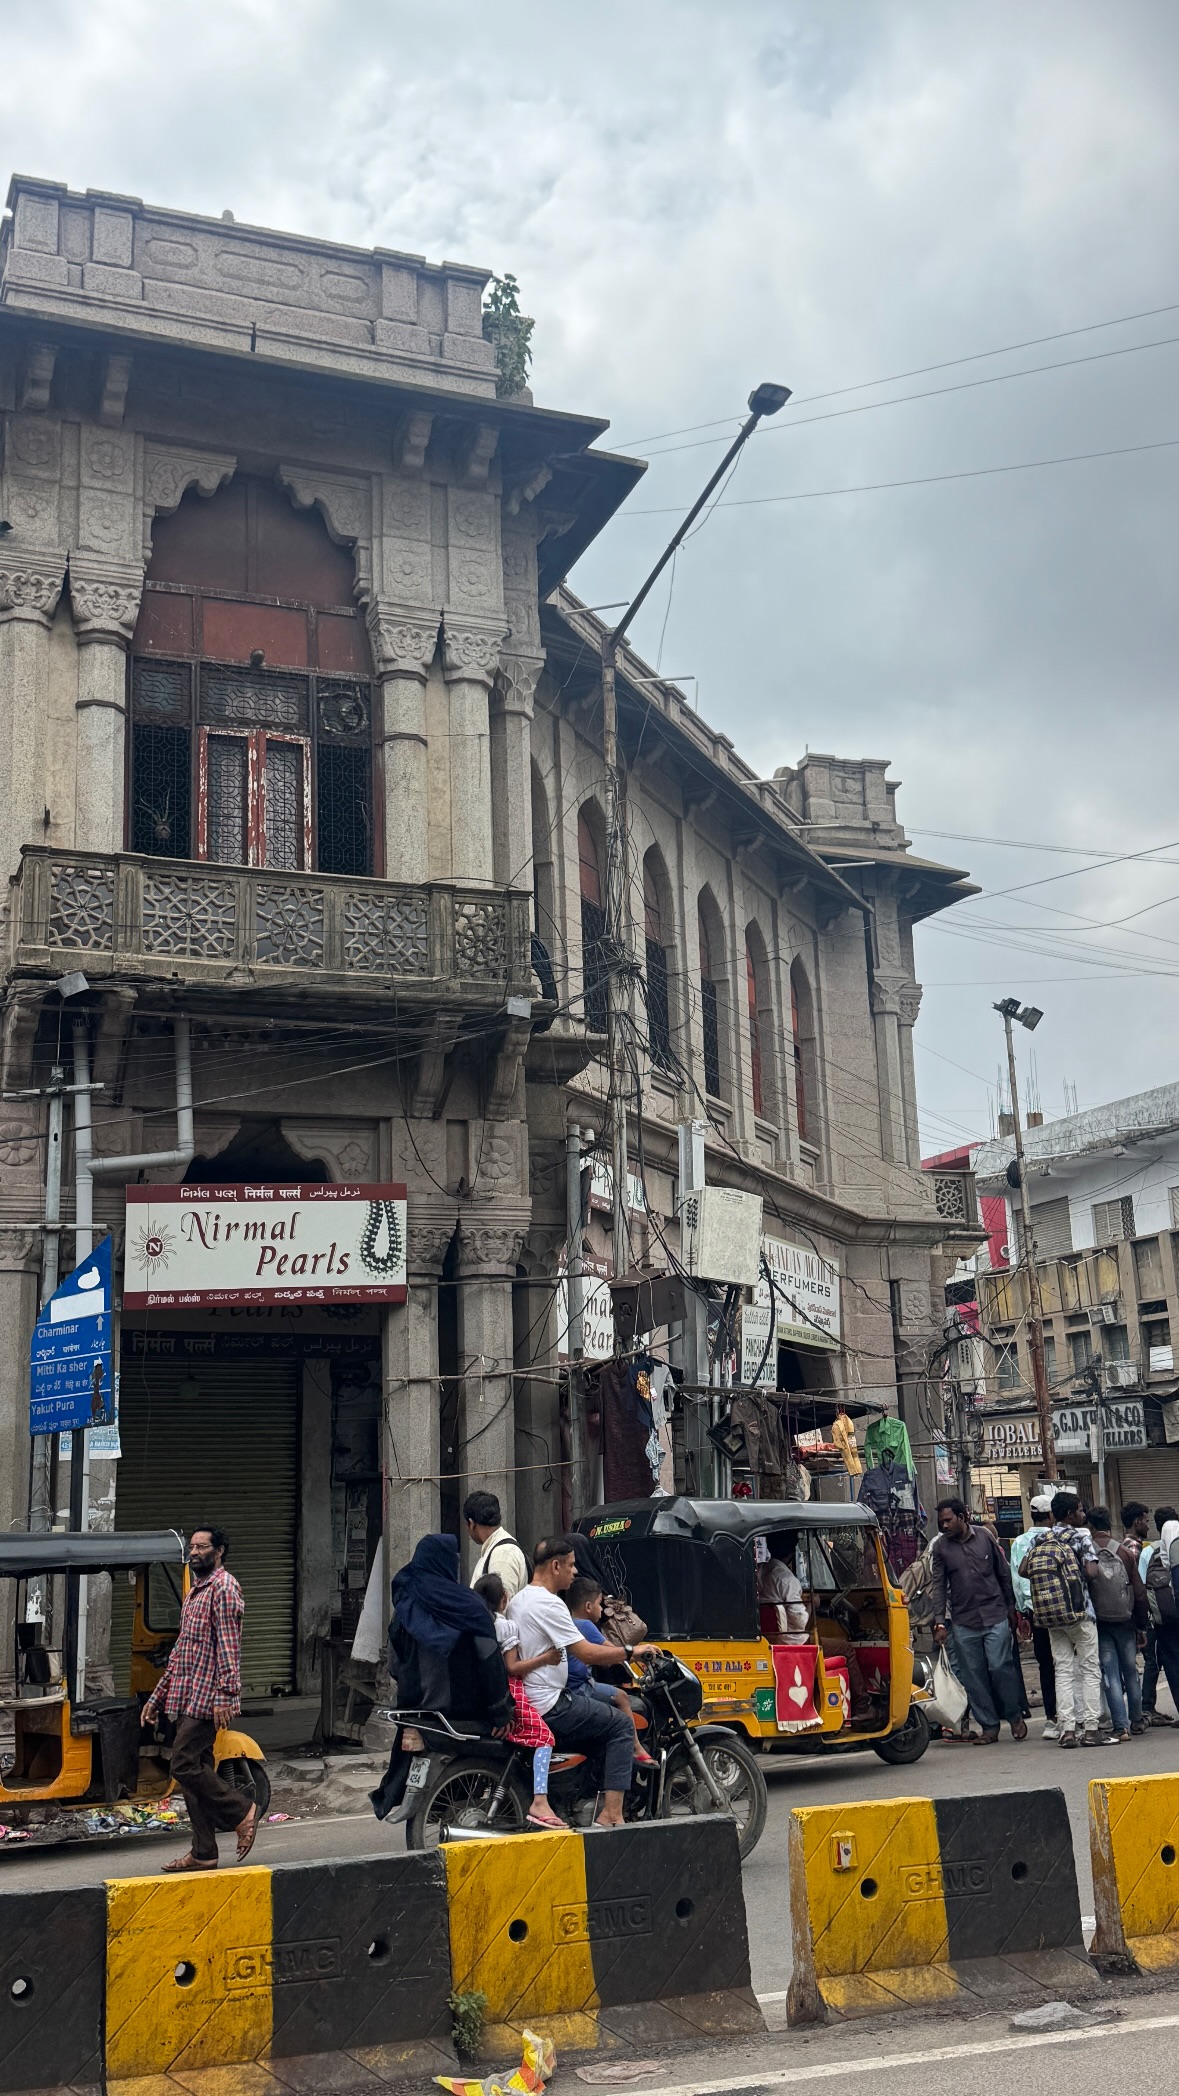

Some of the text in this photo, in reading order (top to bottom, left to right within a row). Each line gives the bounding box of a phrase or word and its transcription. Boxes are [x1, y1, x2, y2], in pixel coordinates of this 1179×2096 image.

[244, 1186, 274, 1199] निर्मल
[180, 1211, 301, 1250] Nirmal
[148, 1242, 162, 1253] N
[255, 1242, 351, 1276] Pearls
[768, 1268, 831, 1298] ERFUMERS
[37, 1324, 80, 1339] Charminar
[36, 1361, 88, 1376] Mitti Ka sher
[31, 1400, 75, 1415] Yakut Pura
[1059, 1407, 1114, 1433] G.D.KHN
[986, 1422, 1039, 1447] IQBAL
[1085, 1429, 1143, 1448] JELLERS
[987, 1445, 1043, 1458] JEWELLERS
[712, 1661, 722, 1672] IN
[724, 1661, 743, 1672] ALL
[904, 1865, 987, 1896] GHMC
[558, 1902, 648, 1939] GHMC
[234, 1945, 337, 1980] GHMC
